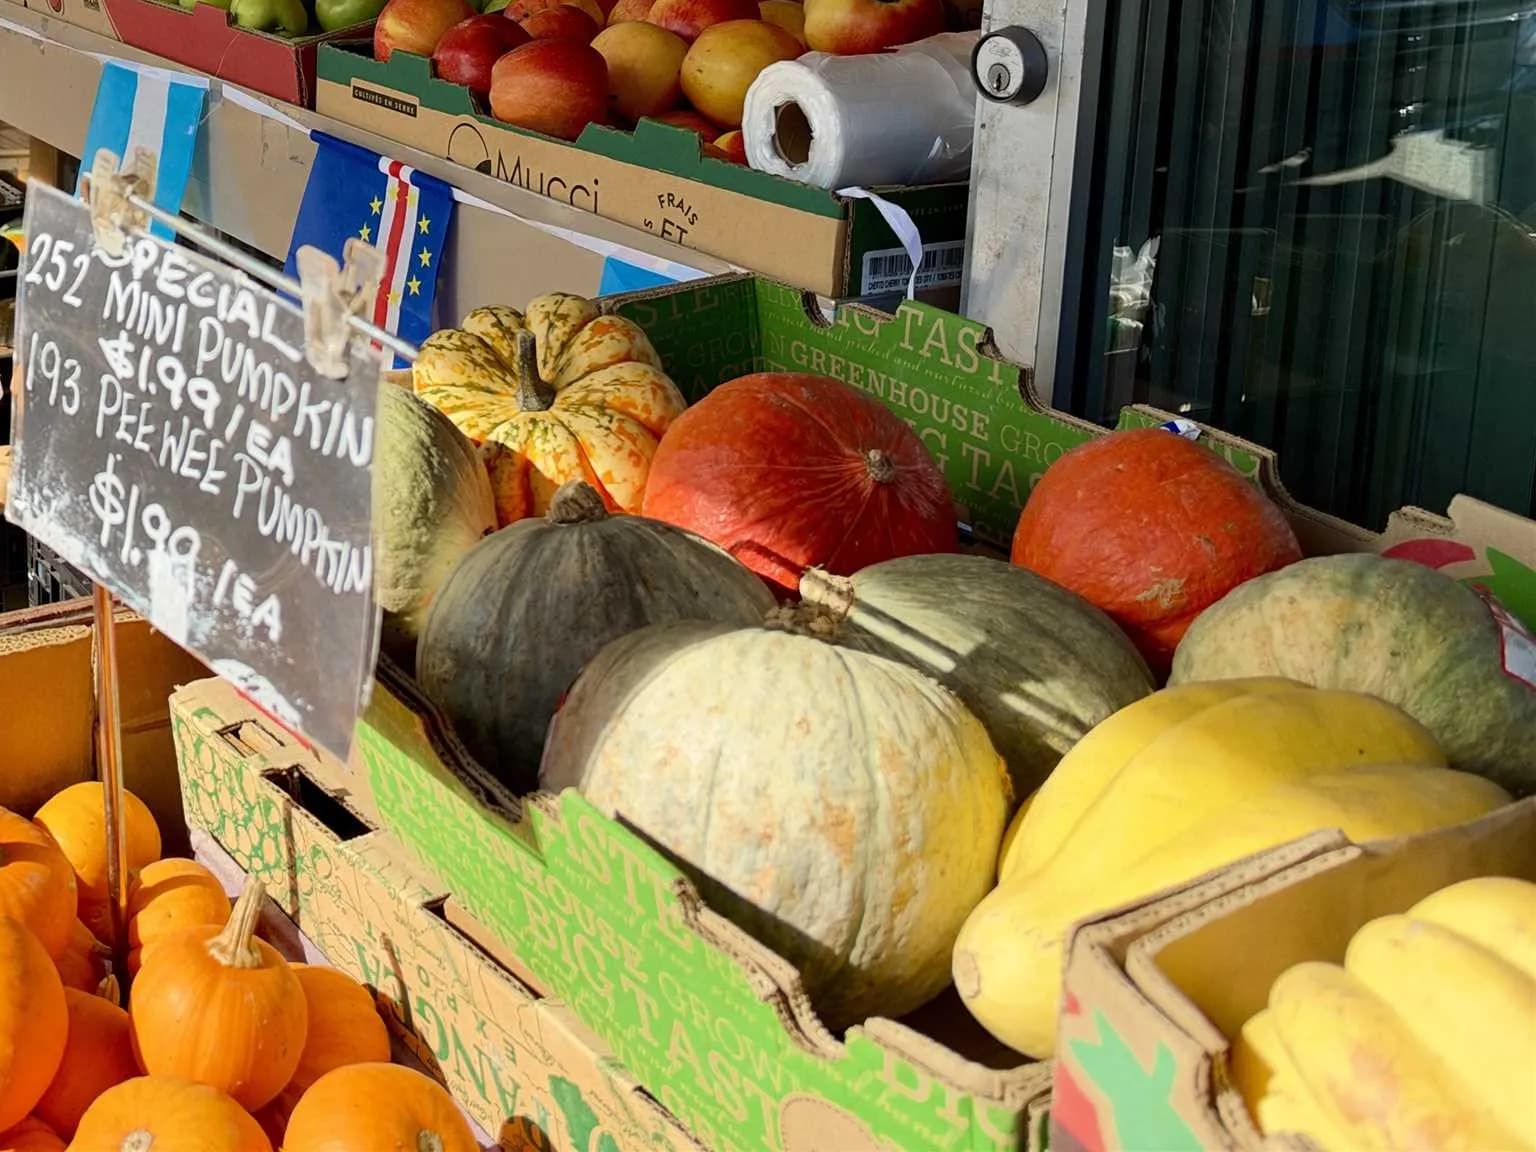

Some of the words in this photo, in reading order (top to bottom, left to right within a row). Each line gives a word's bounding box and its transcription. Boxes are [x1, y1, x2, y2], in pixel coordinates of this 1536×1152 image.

[657, 192, 699, 226] FRAIS
[25, 233, 89, 307] 252
[25, 330, 83, 417] 193
[103, 271, 186, 348] MINI
[195, 316, 374, 466] PUMPKIN
[790, 339, 990, 442] GREENHOUSE
[96, 373, 156, 454] PEE
[159, 419, 229, 495] WEE
[233, 451, 373, 596] PUMPKIN
